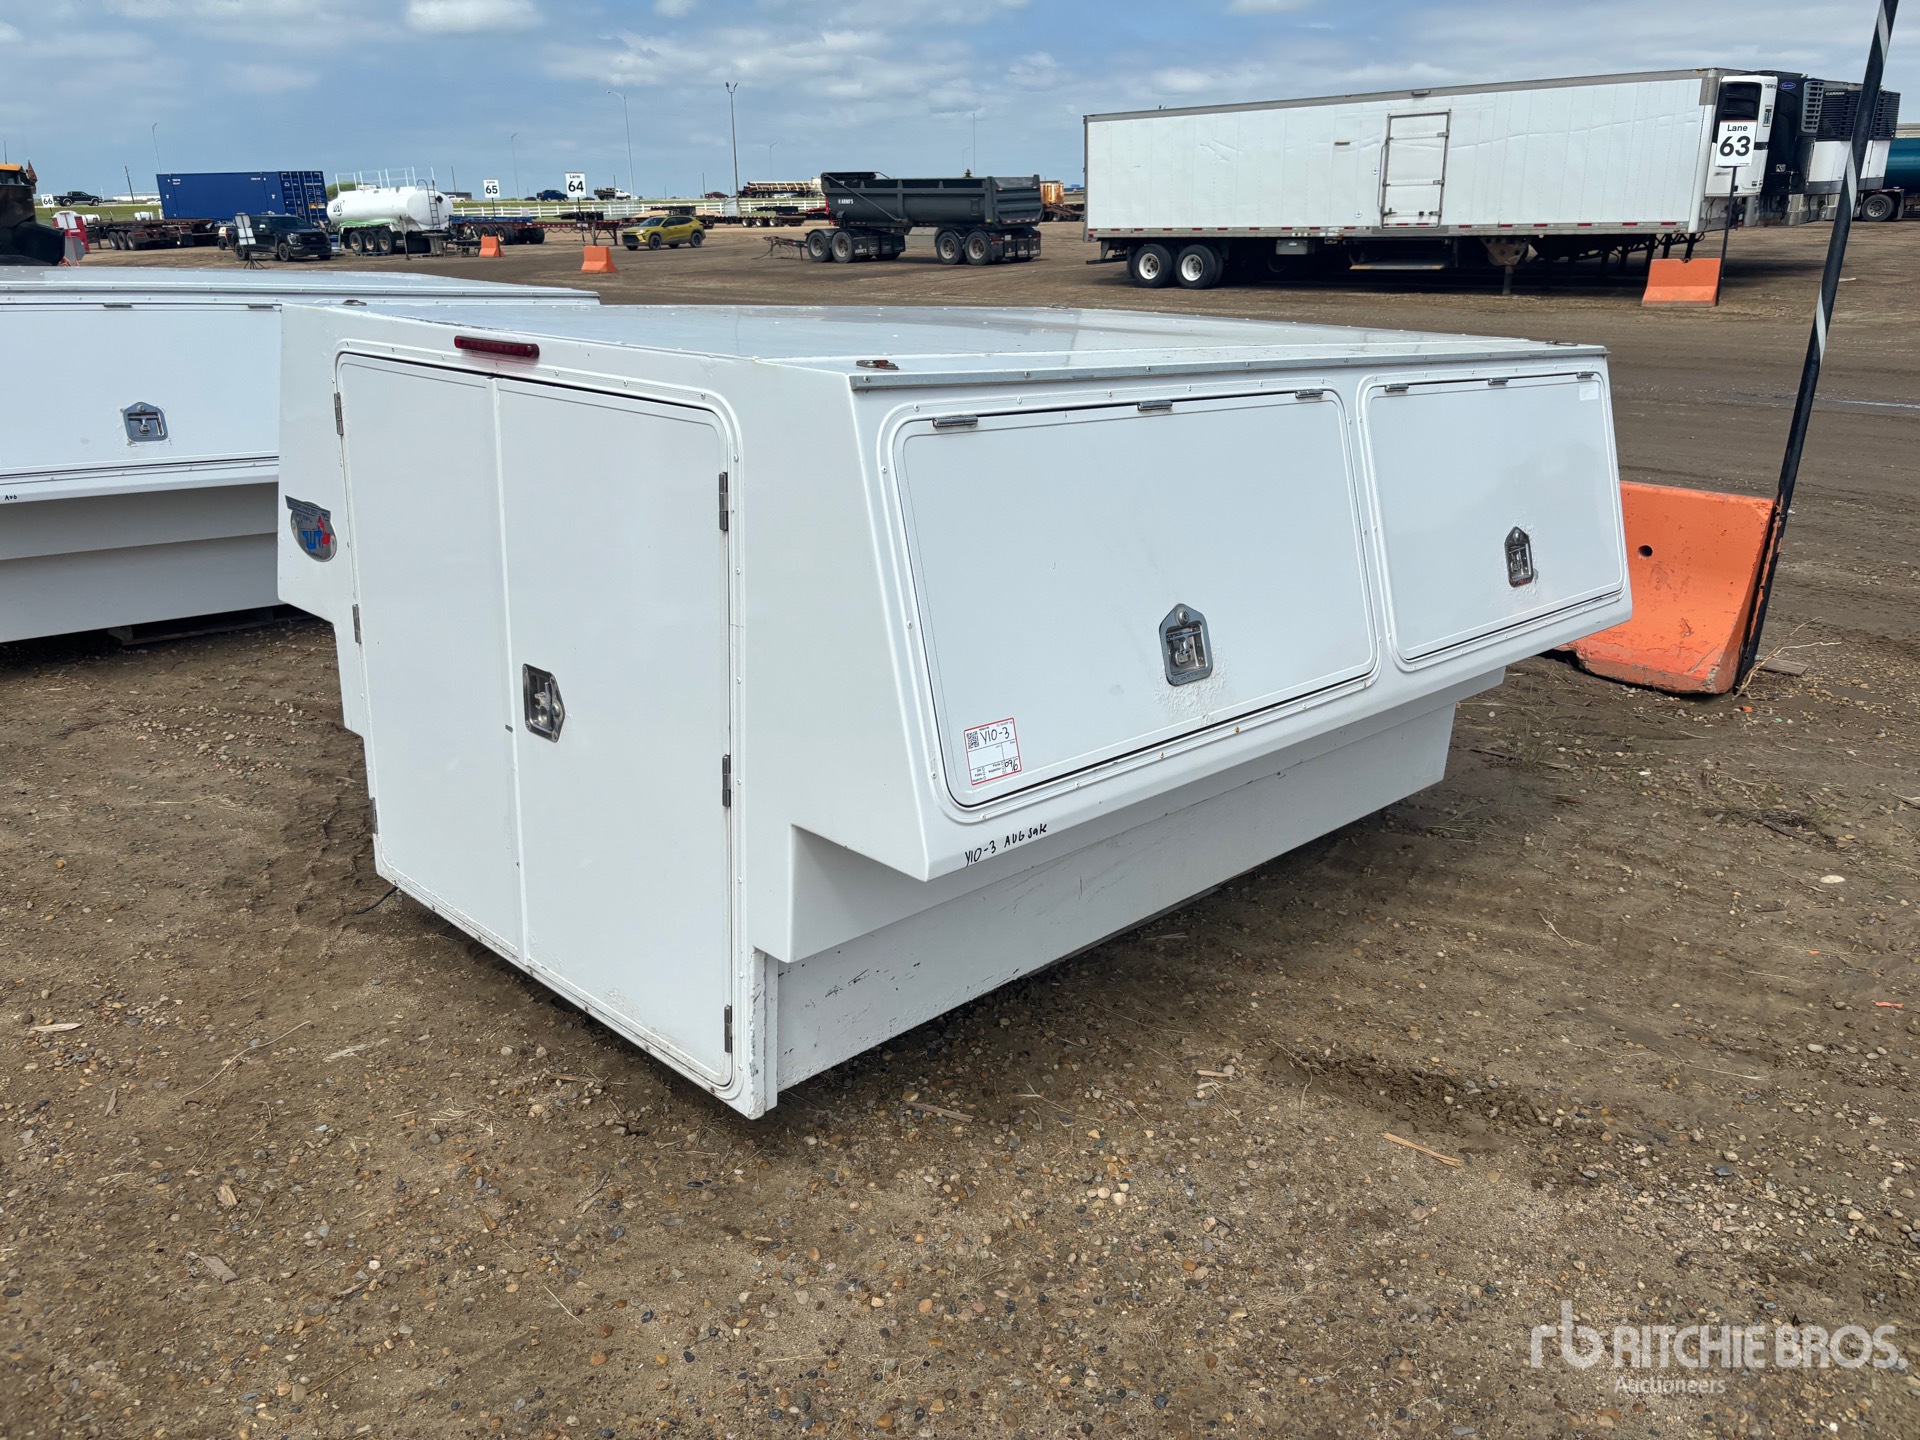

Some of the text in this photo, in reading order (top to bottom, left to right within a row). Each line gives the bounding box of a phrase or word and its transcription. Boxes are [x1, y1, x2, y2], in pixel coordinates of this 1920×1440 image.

[1727, 124, 1748, 132] Lane
[1719, 135, 1751, 157] 63
[485, 185, 498, 194] 65
[567, 180, 584, 193] 64
